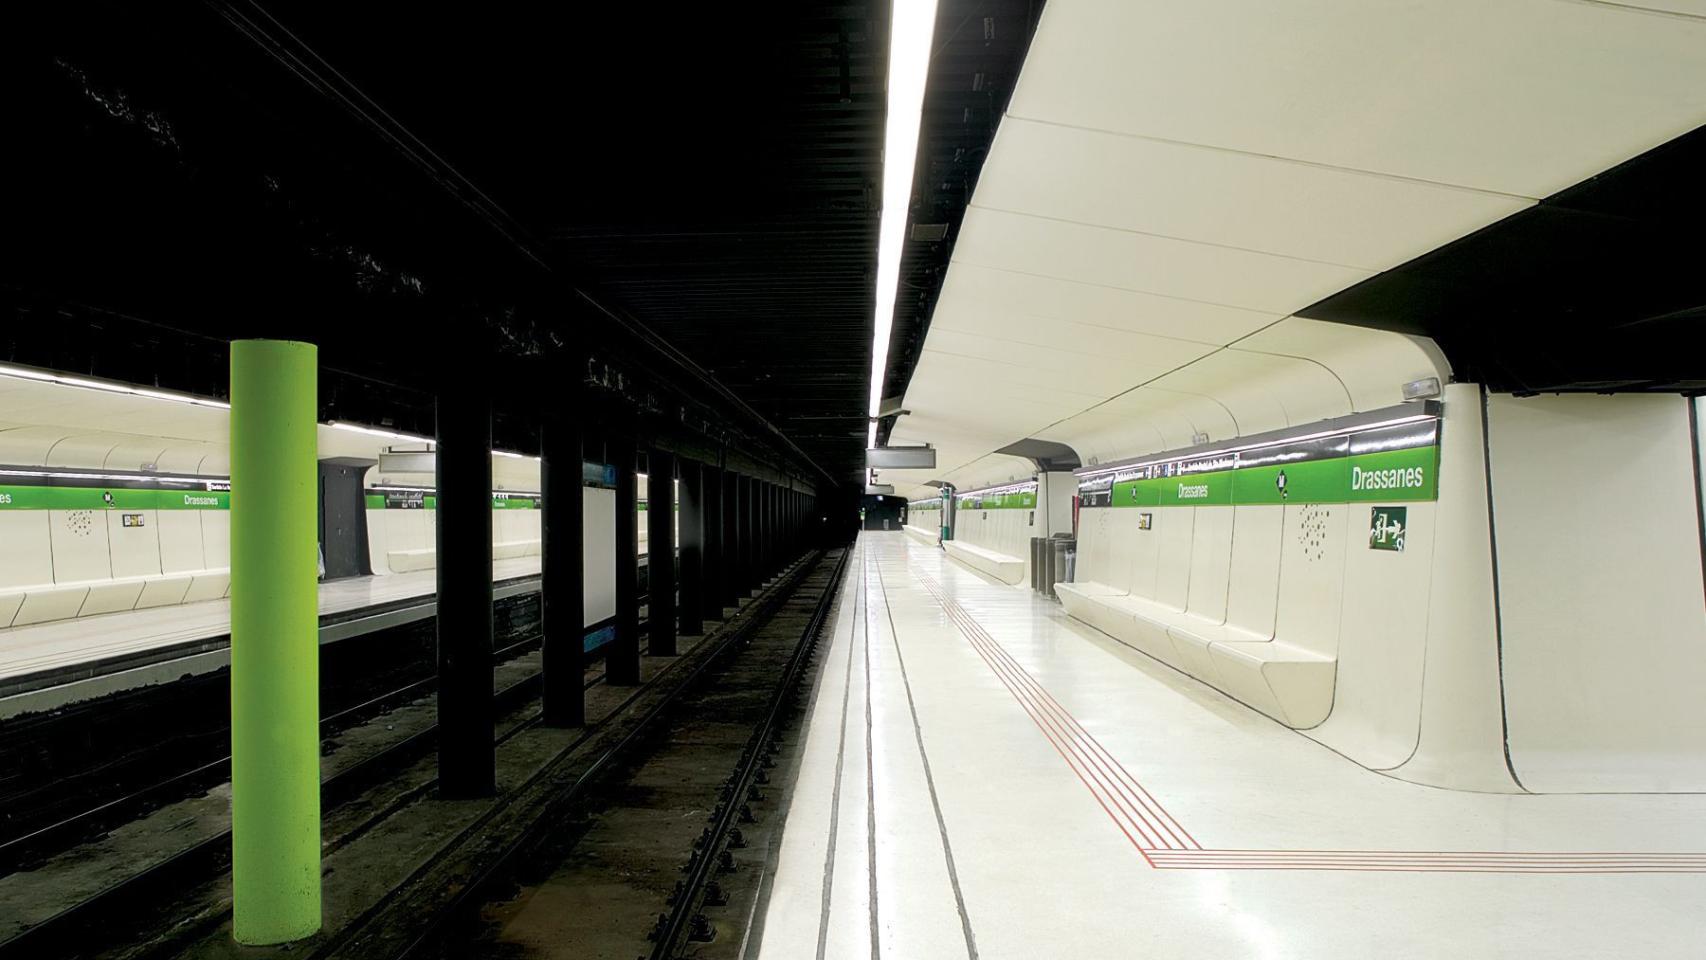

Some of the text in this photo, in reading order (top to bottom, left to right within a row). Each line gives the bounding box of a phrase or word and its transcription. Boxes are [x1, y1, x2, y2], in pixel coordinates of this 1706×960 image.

[1352, 466, 1423, 490] Drassanes
[1178, 483, 1208, 499] Drassanes
[184, 494, 219, 506] Drassanes
